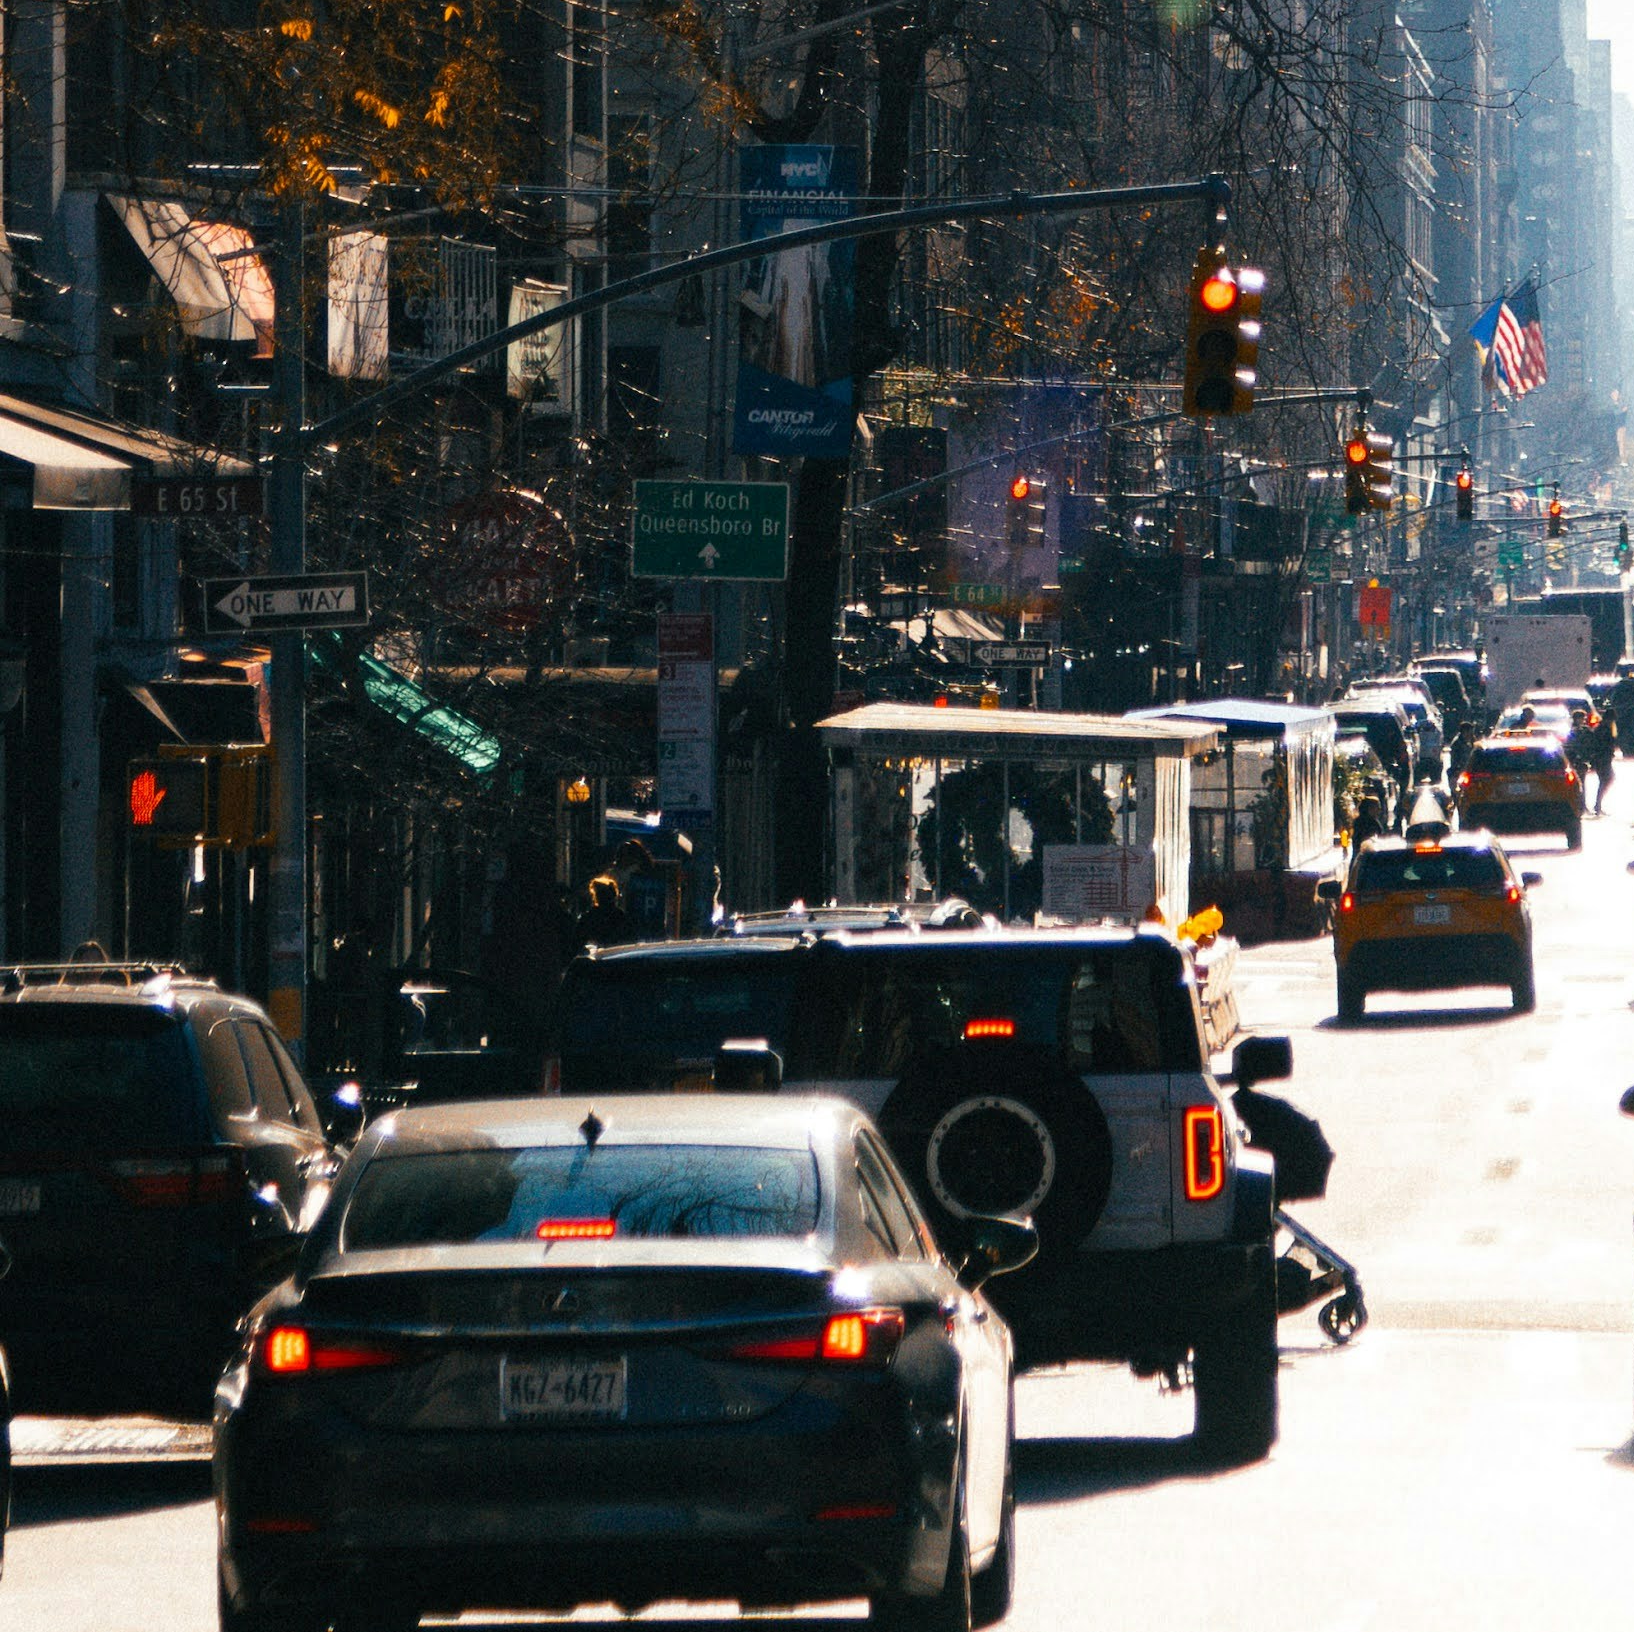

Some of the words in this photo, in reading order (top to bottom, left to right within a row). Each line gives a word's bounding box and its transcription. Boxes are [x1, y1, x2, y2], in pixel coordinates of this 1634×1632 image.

[781, 162, 818, 177] NYC
[748, 189, 849, 204] FINANCIAL
[747, 408, 816, 425] CANTOR
[157, 487, 168, 512] E
[180, 486, 205, 512] 65
[216, 486, 239, 512] St
[672, 489, 694, 509] Ed
[704, 490, 750, 511] Koch
[639, 513, 752, 535] Queensboro
[762, 517, 781, 536] Br
[230, 593, 276, 615] ONE
[297, 589, 346, 612] WAY
[982, 647, 1005, 660] ONE
[1016, 647, 1040, 660] WAY
